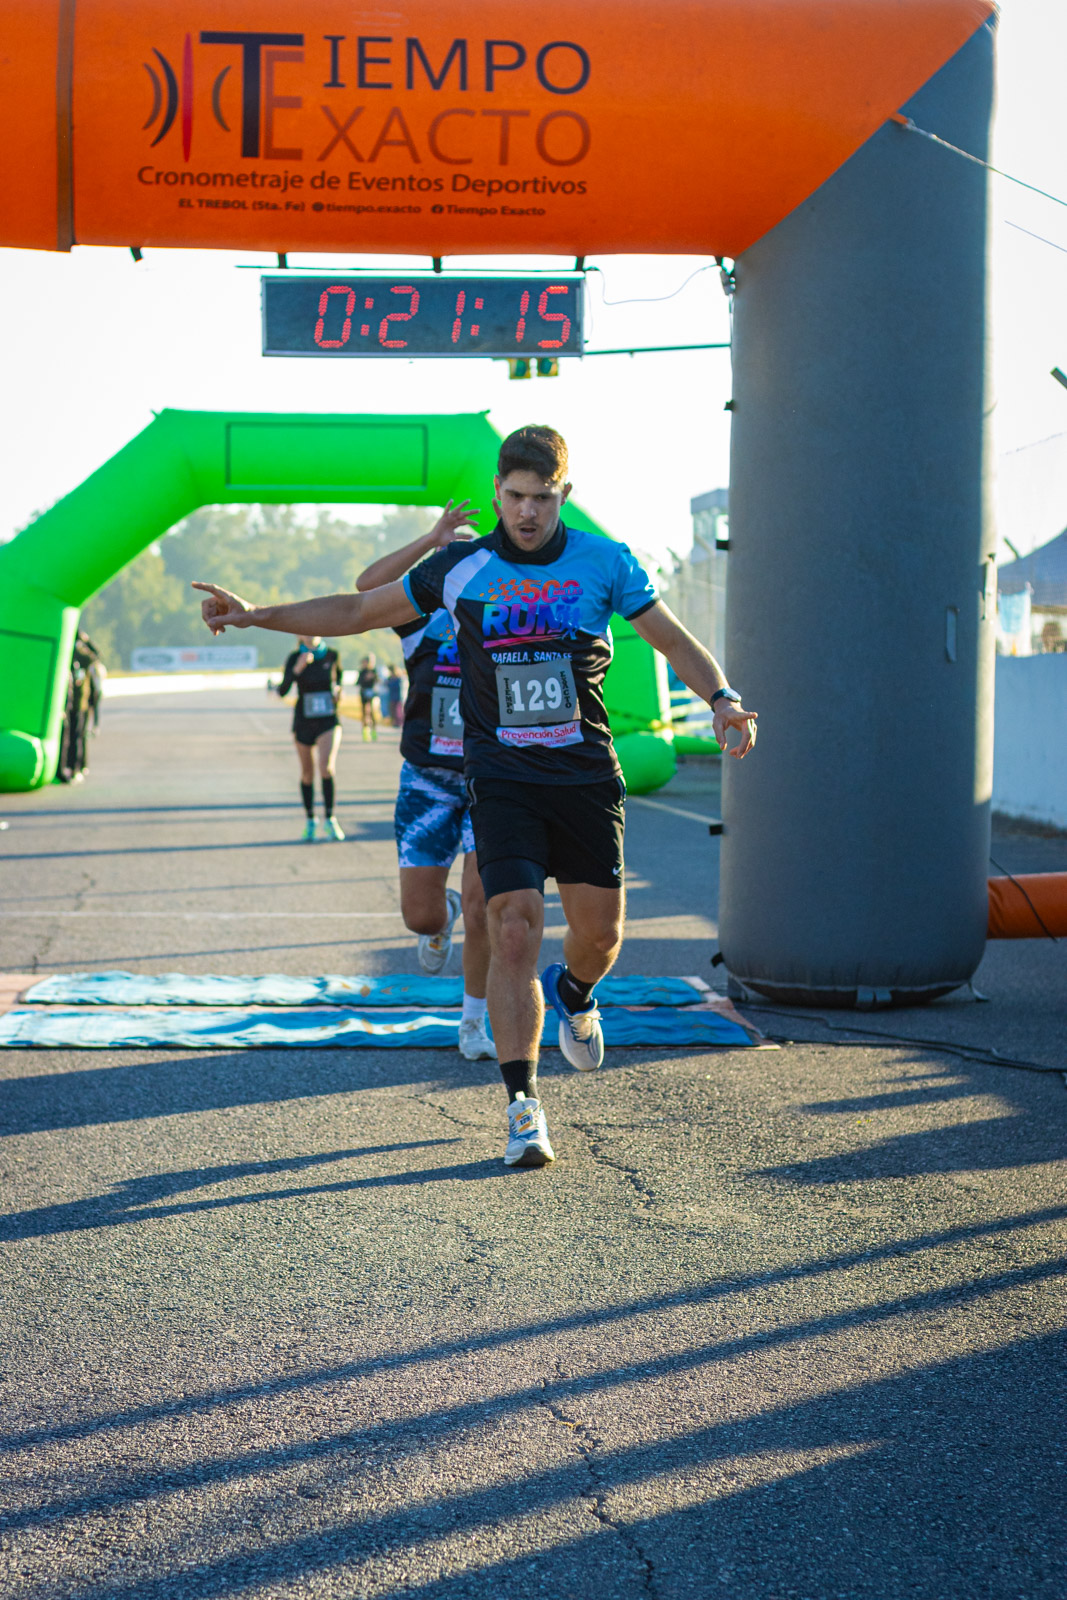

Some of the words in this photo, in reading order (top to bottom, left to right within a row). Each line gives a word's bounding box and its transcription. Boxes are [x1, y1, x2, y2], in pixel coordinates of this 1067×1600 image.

[137, 165, 304, 192] Cronometraje
[310, 170, 341, 190] de
[348, 171, 444, 192] Eventos
[451, 173, 588, 197] Deportivos
[178, 198, 194, 208] EL
[197, 199, 248, 210] TREBOL
[285, 201, 305, 212] Fe)
[446, 204, 498, 216] Tiempo
[501, 206, 546, 216] Exacto
[511, 677, 562, 712] 129
[554, 724, 576, 737] Salud
